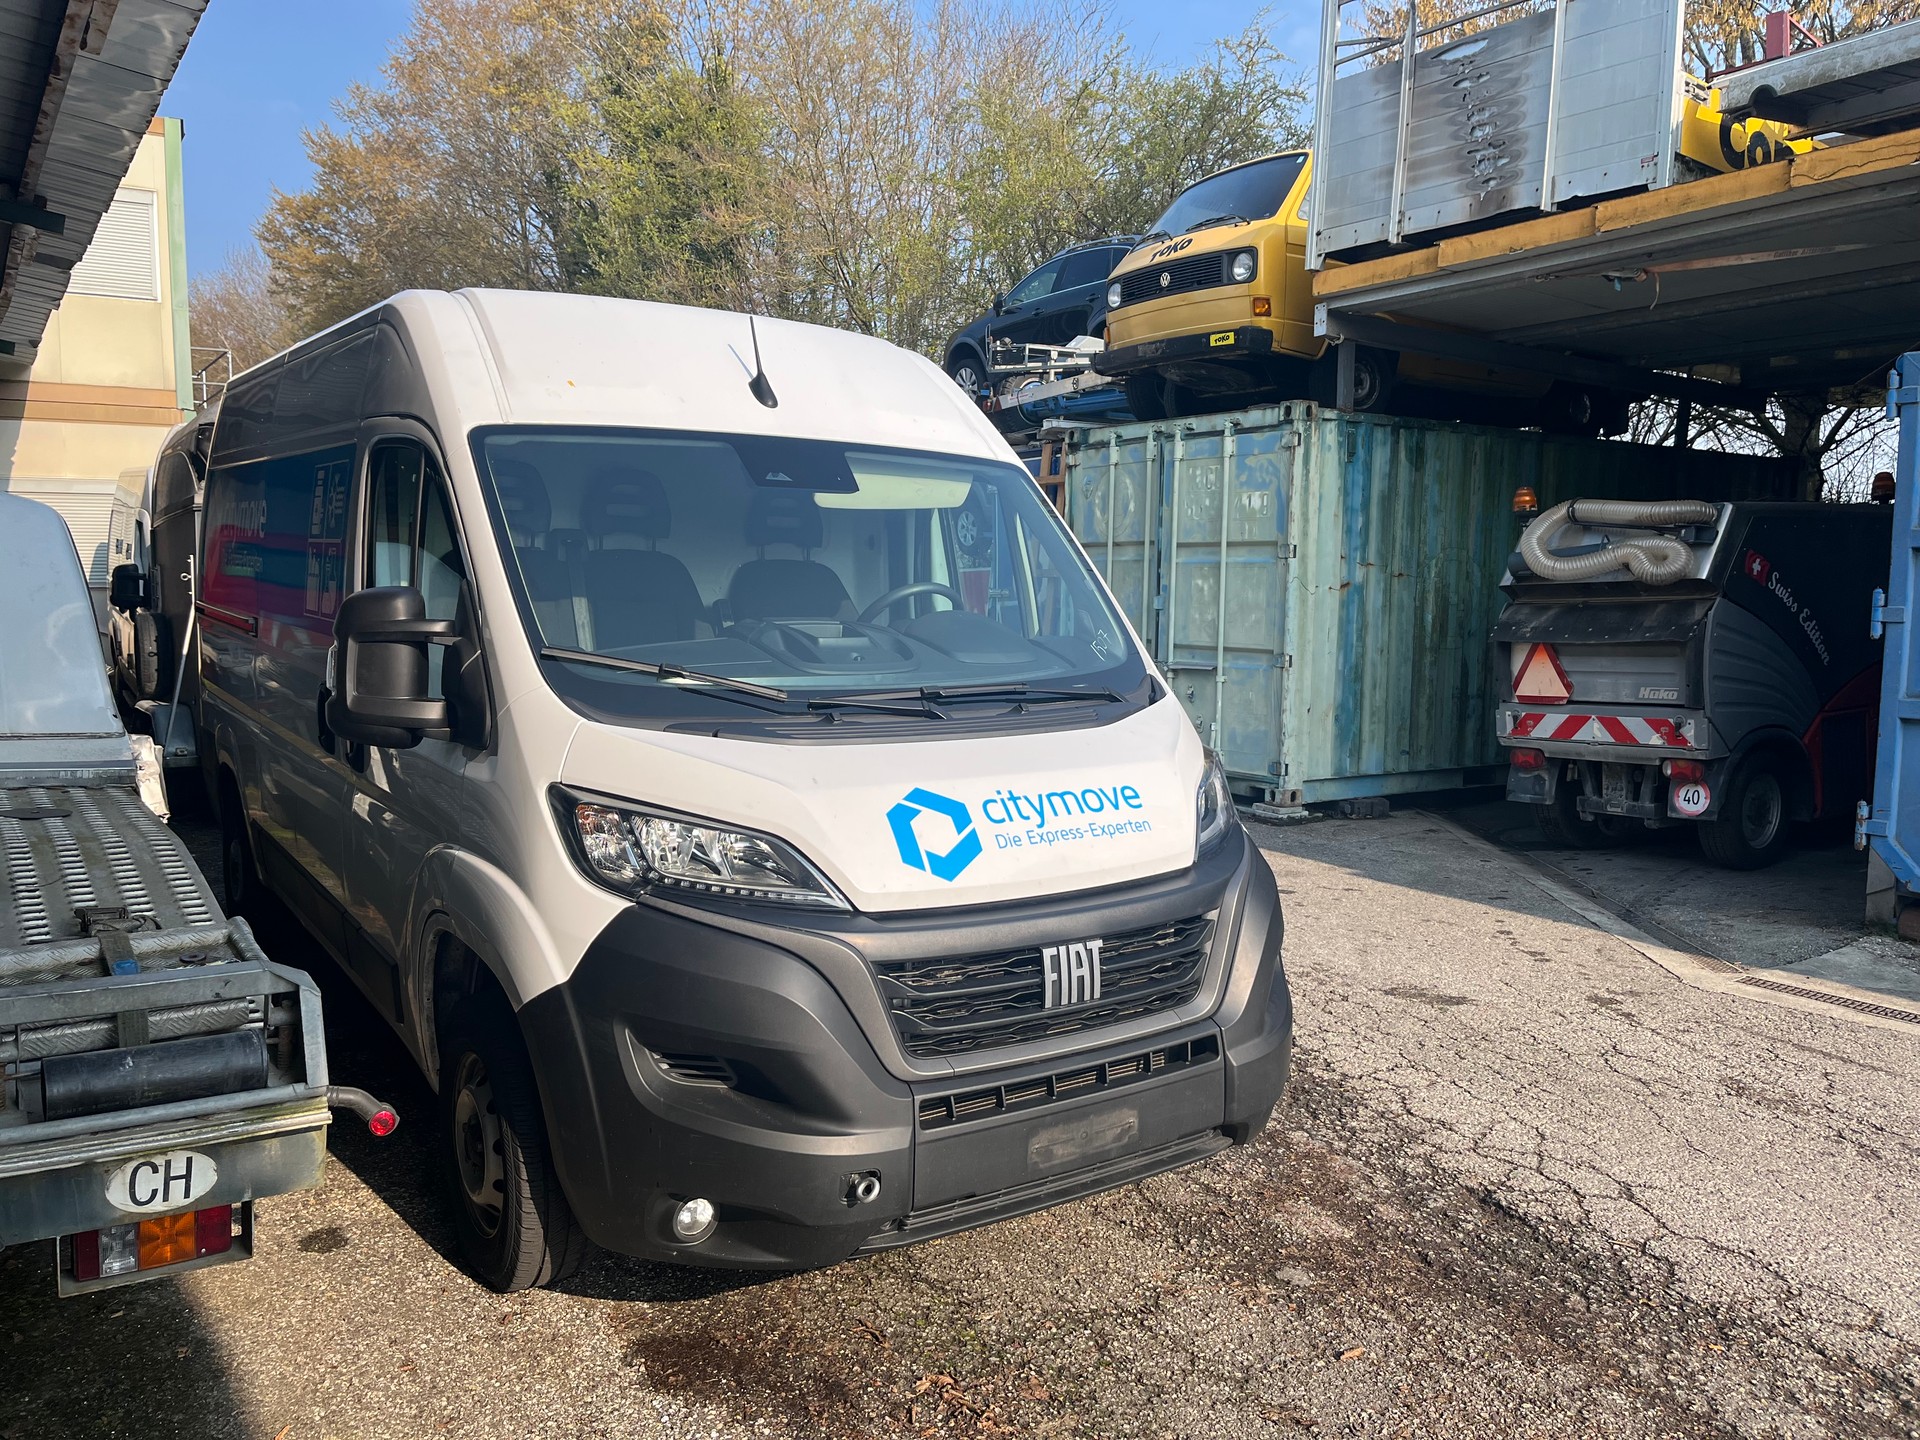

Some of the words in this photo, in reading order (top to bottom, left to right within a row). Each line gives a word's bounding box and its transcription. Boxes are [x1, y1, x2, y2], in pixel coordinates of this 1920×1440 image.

[1149, 238, 1193, 263] TOKO
[1214, 333, 1230, 345] TOKO
[1768, 571, 1798, 613] Swiss
[1799, 608, 1831, 666] Edition
[1638, 687, 1680, 700] Hako
[982, 783, 1143, 828] citymove
[1683, 789, 1700, 805] 40
[995, 832, 1023, 849] Die
[1028, 818, 1152, 847] Express-Experten
[1042, 939, 1104, 1009] FIAT
[128, 1155, 194, 1207] CH
